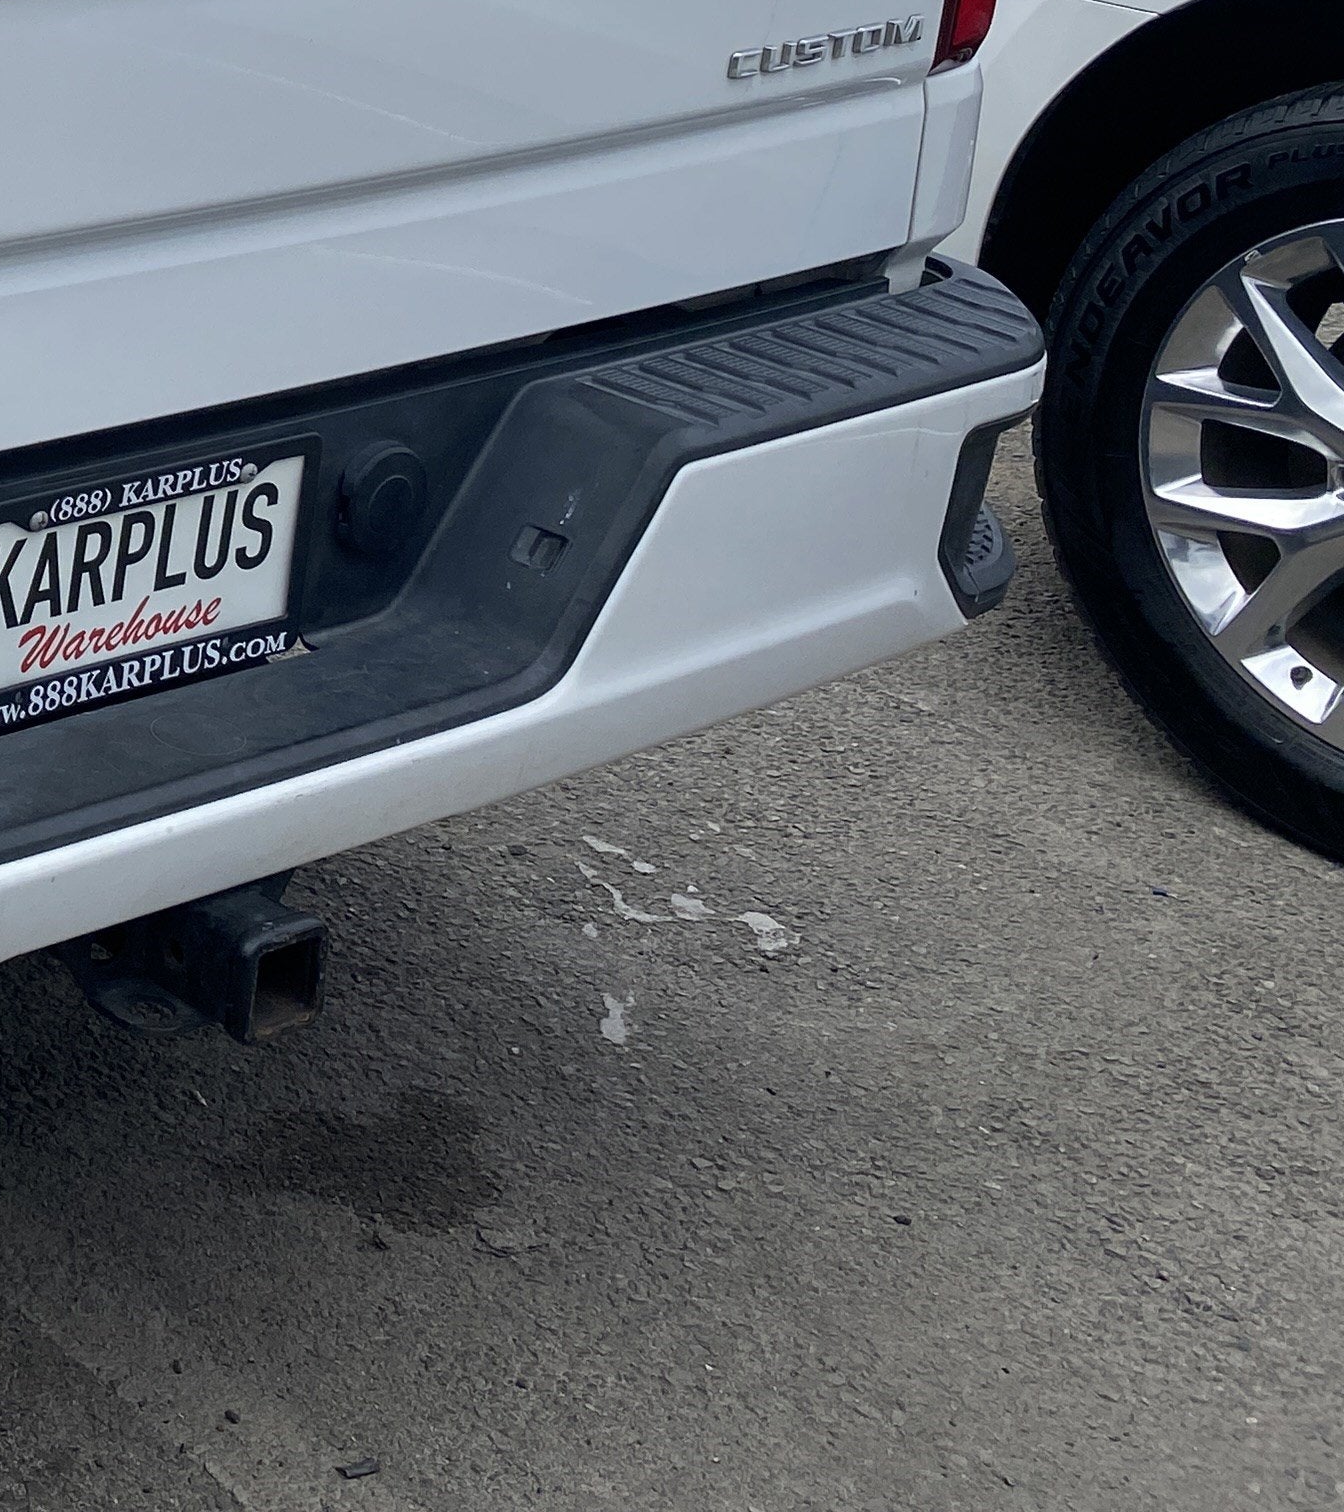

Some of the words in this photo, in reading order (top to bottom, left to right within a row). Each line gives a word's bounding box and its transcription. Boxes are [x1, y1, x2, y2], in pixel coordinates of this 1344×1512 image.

[727, 13, 926, 79] CUSTOM
[1062, 163, 1255, 418] NDEAVOR
[50, 487, 112, 522] (888)
[119, 458, 243, 507] KARPLUS
[17, 595, 221, 674] Warehouse
